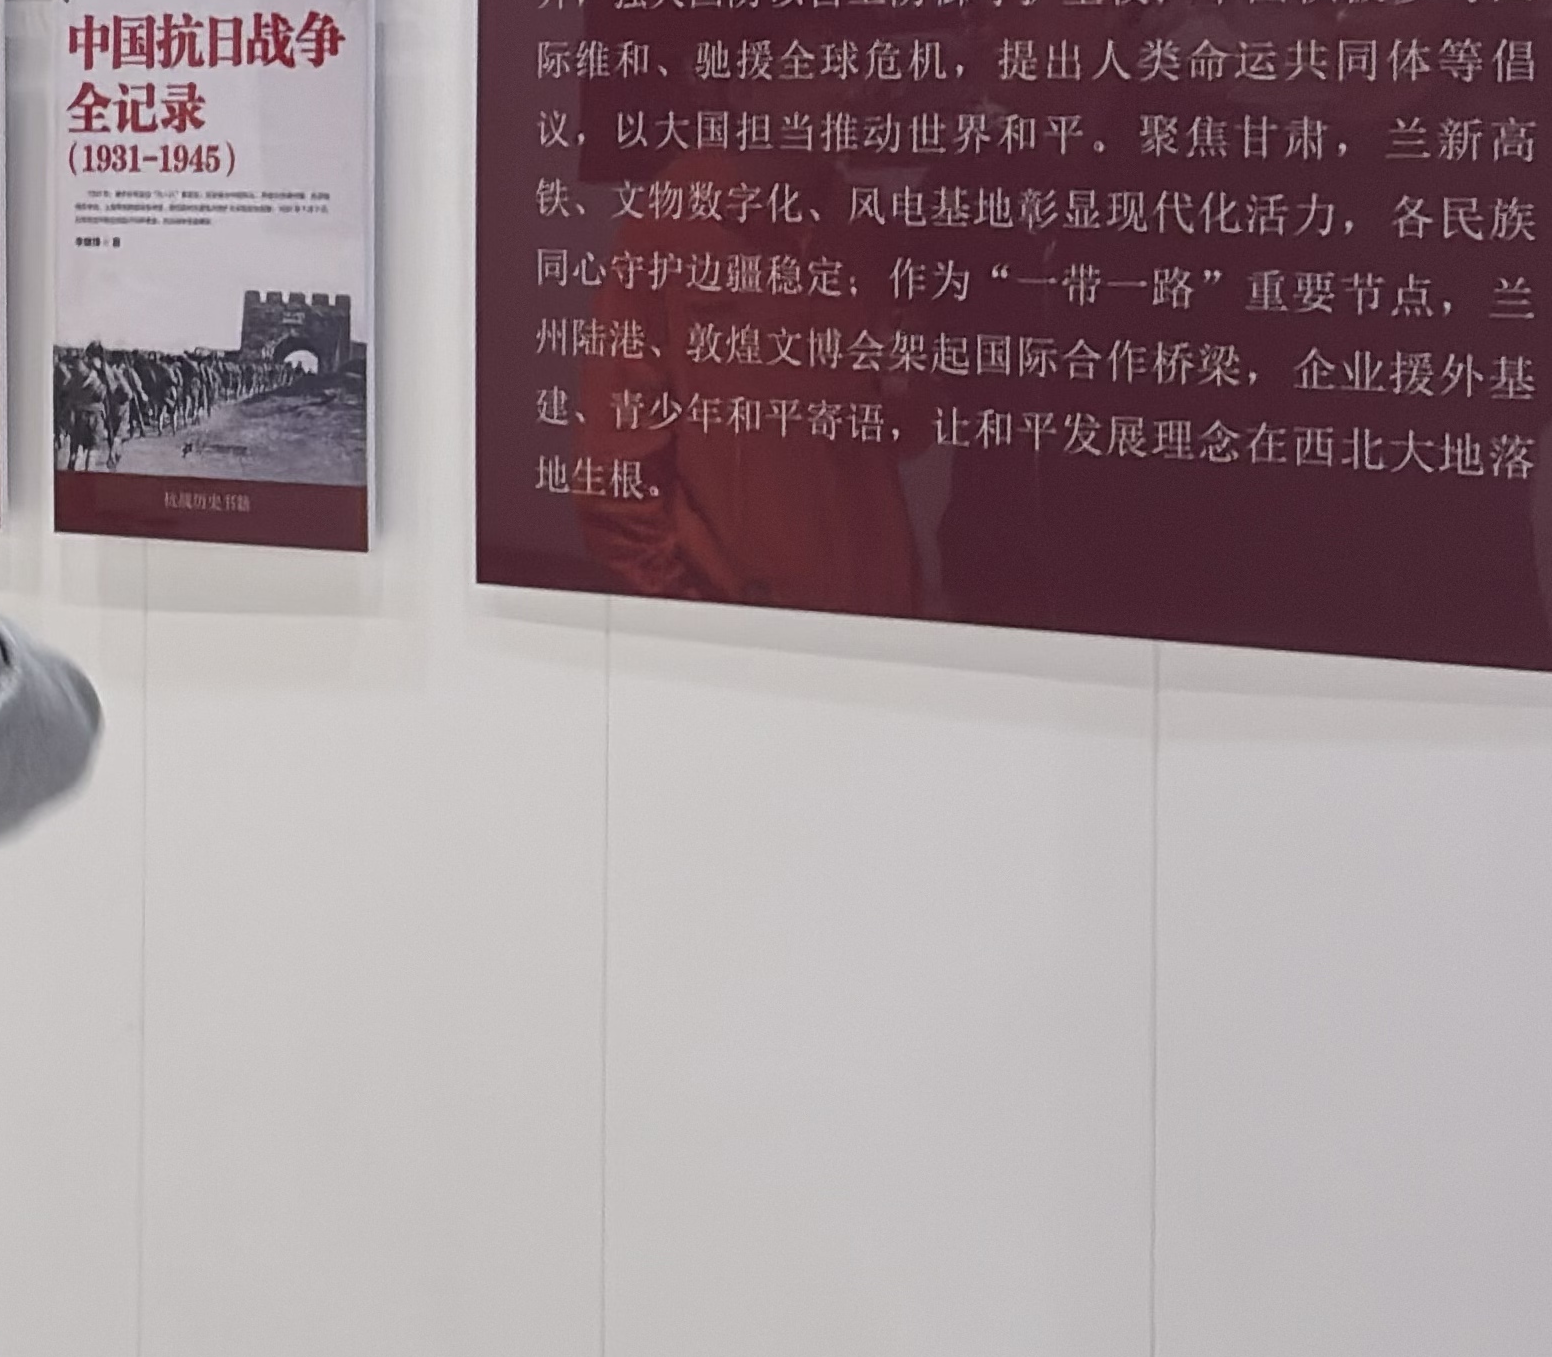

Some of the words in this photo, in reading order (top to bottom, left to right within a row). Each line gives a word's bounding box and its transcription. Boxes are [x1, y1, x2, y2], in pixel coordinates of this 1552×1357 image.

[67, 11, 345, 70] 中国抗日战争
[537, 38, 1536, 83] 际维和、驰援全球危机，提出人类命运共同体等倡
[67, 82, 206, 133] 全记录
[537, 110, 1538, 163] 议，以大国担当推动世界和平。聚焦甘肃，兰新高
[536, 179, 1536, 241] 铁、文物数字化、风电基地彰显现代化活力，各民族
[536, 248, 1535, 319] 同心守护边疆稳定；作为“一带一路”重要节点，兰
[536, 318, 1536, 400] 州陆港、敦煌文博会架起国际合作桥梁，企业援外基
[535, 386, 1535, 480] 建、青少年和平寄语，让和平发展理念在西北大地落
[535, 456, 661, 499] 地生根。
